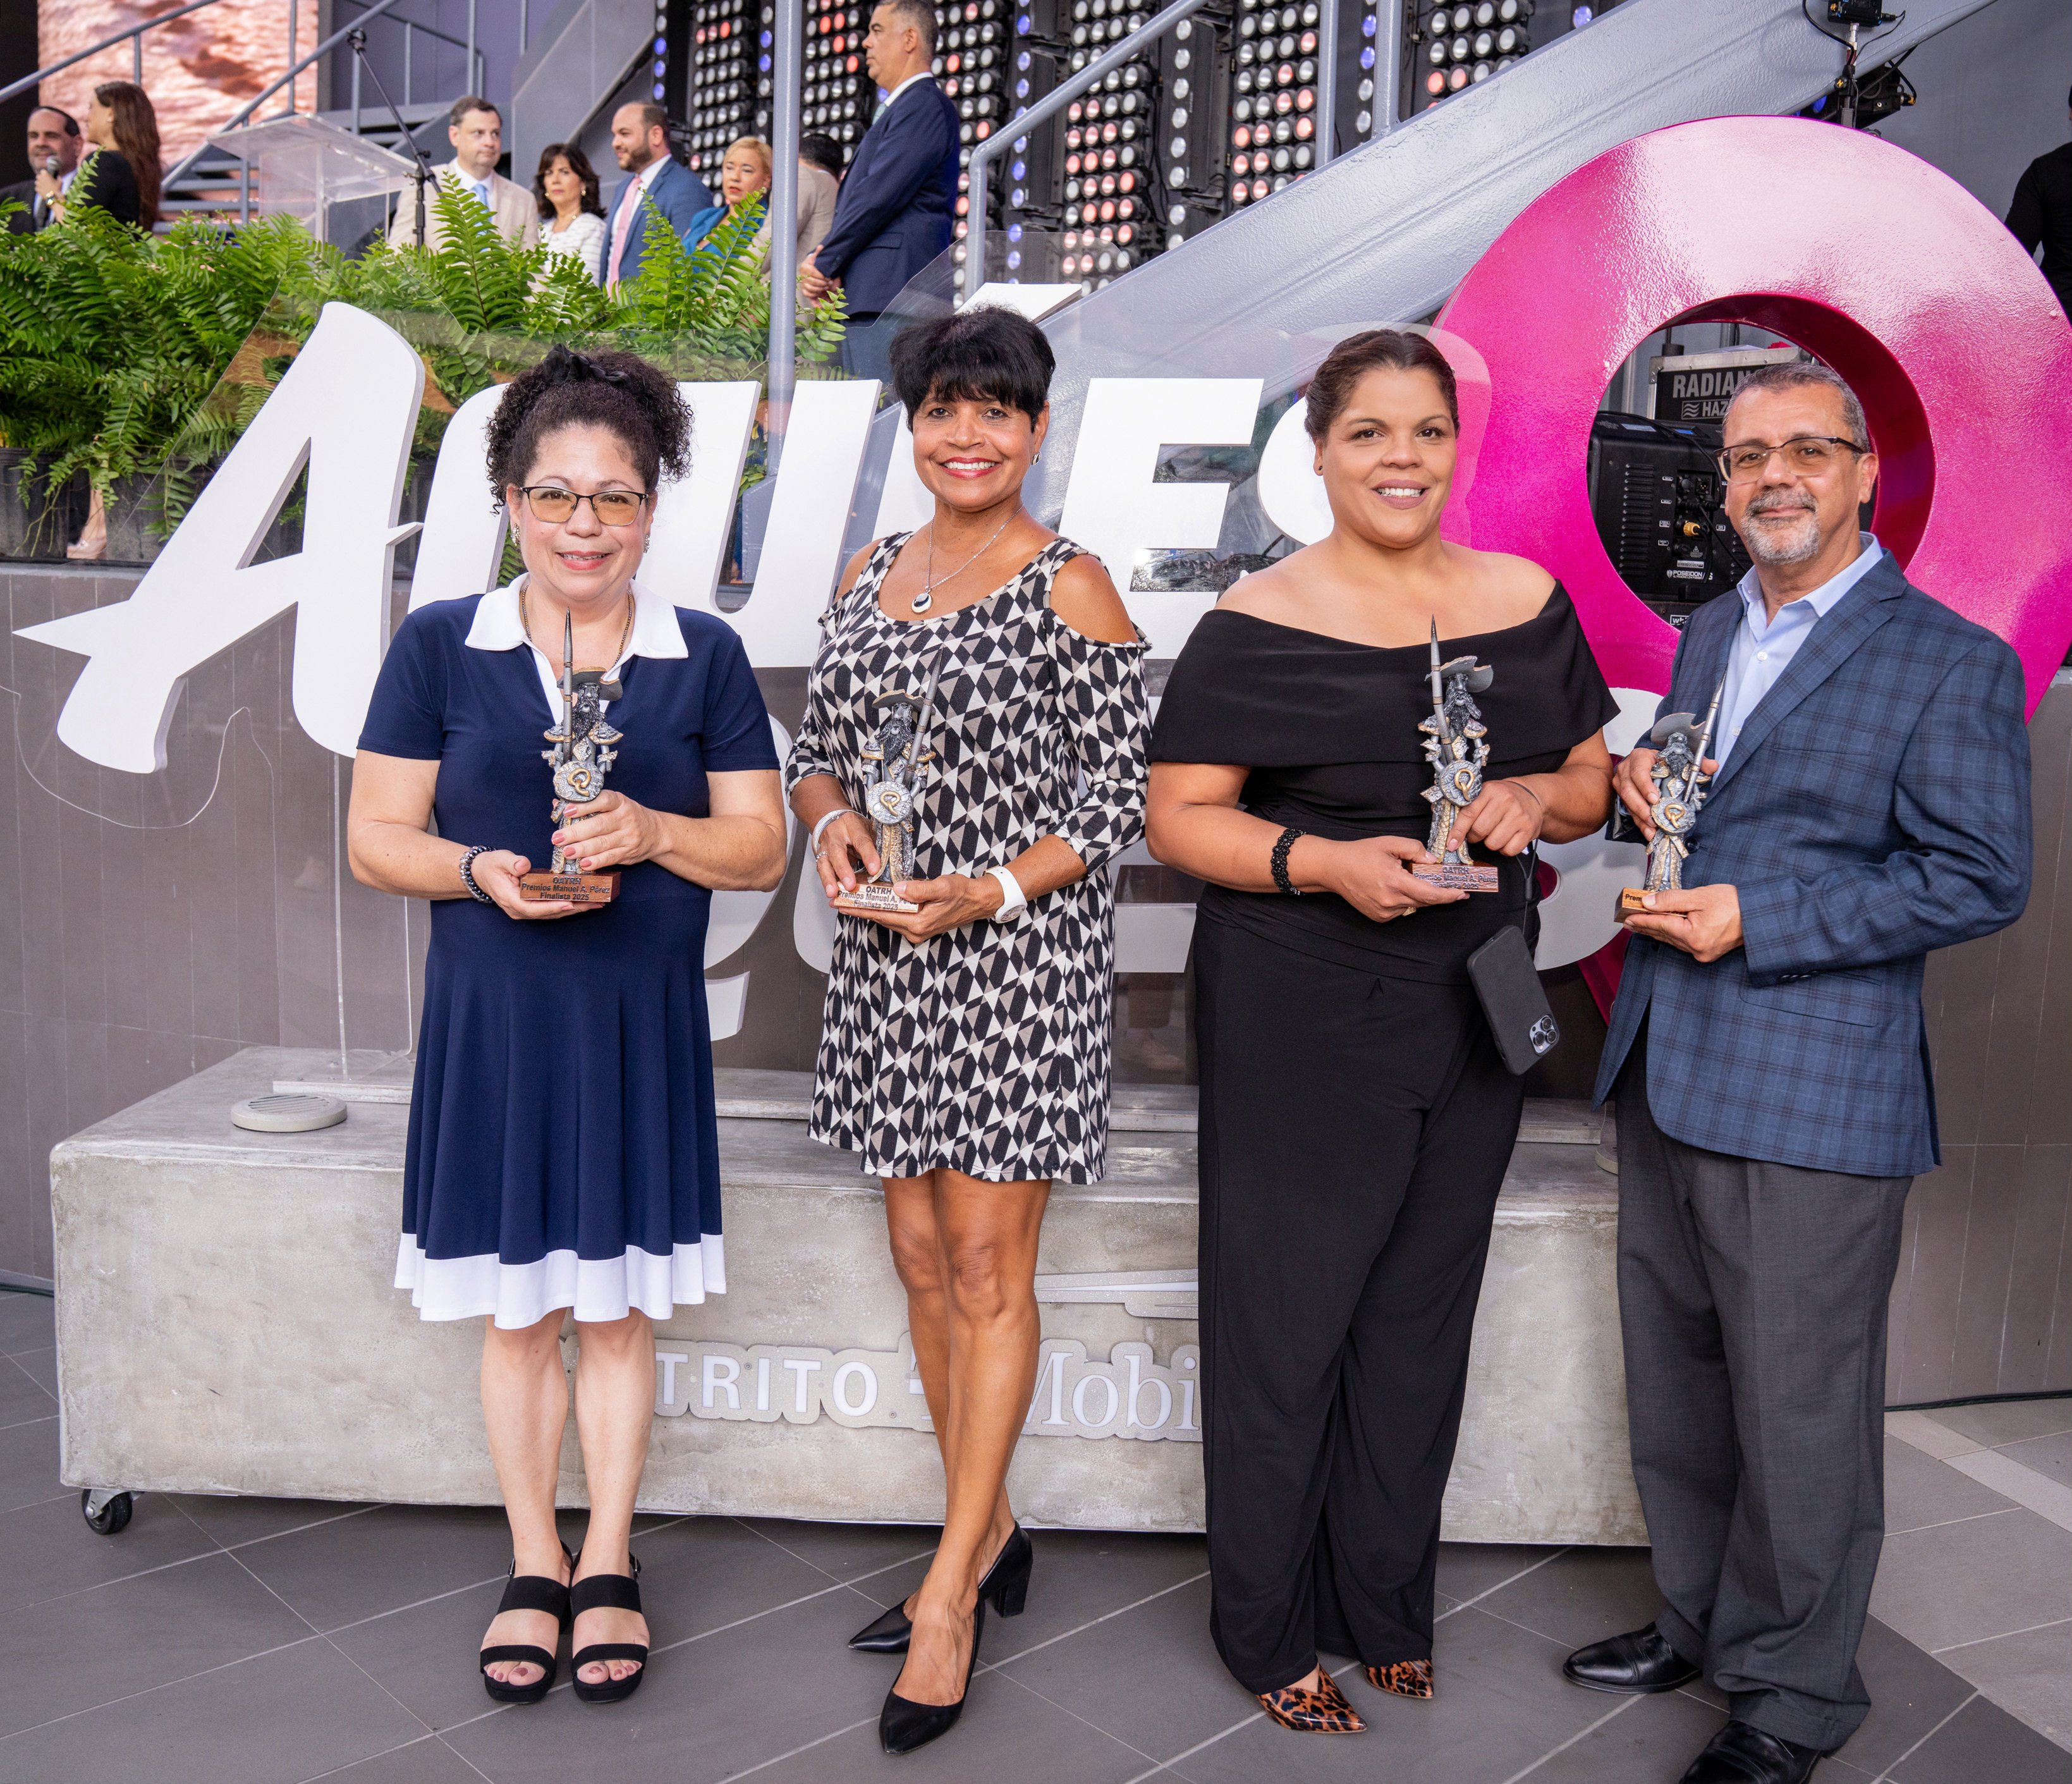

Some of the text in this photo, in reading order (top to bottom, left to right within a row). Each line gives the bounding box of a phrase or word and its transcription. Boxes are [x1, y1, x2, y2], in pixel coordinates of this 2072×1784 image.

[1702, 401, 1728, 417] HAZ
[521, 882, 551, 891] Premios
[552, 884, 579, 892] Manuel
[866, 886, 891, 895] OATRH
[540, 892, 571, 900] Finalista
[837, 890, 864, 900] Premios
[865, 893, 889, 903] Manuel
[1625, 893, 1642, 902] Prem
[853, 899, 898, 911] Finalista 2025
